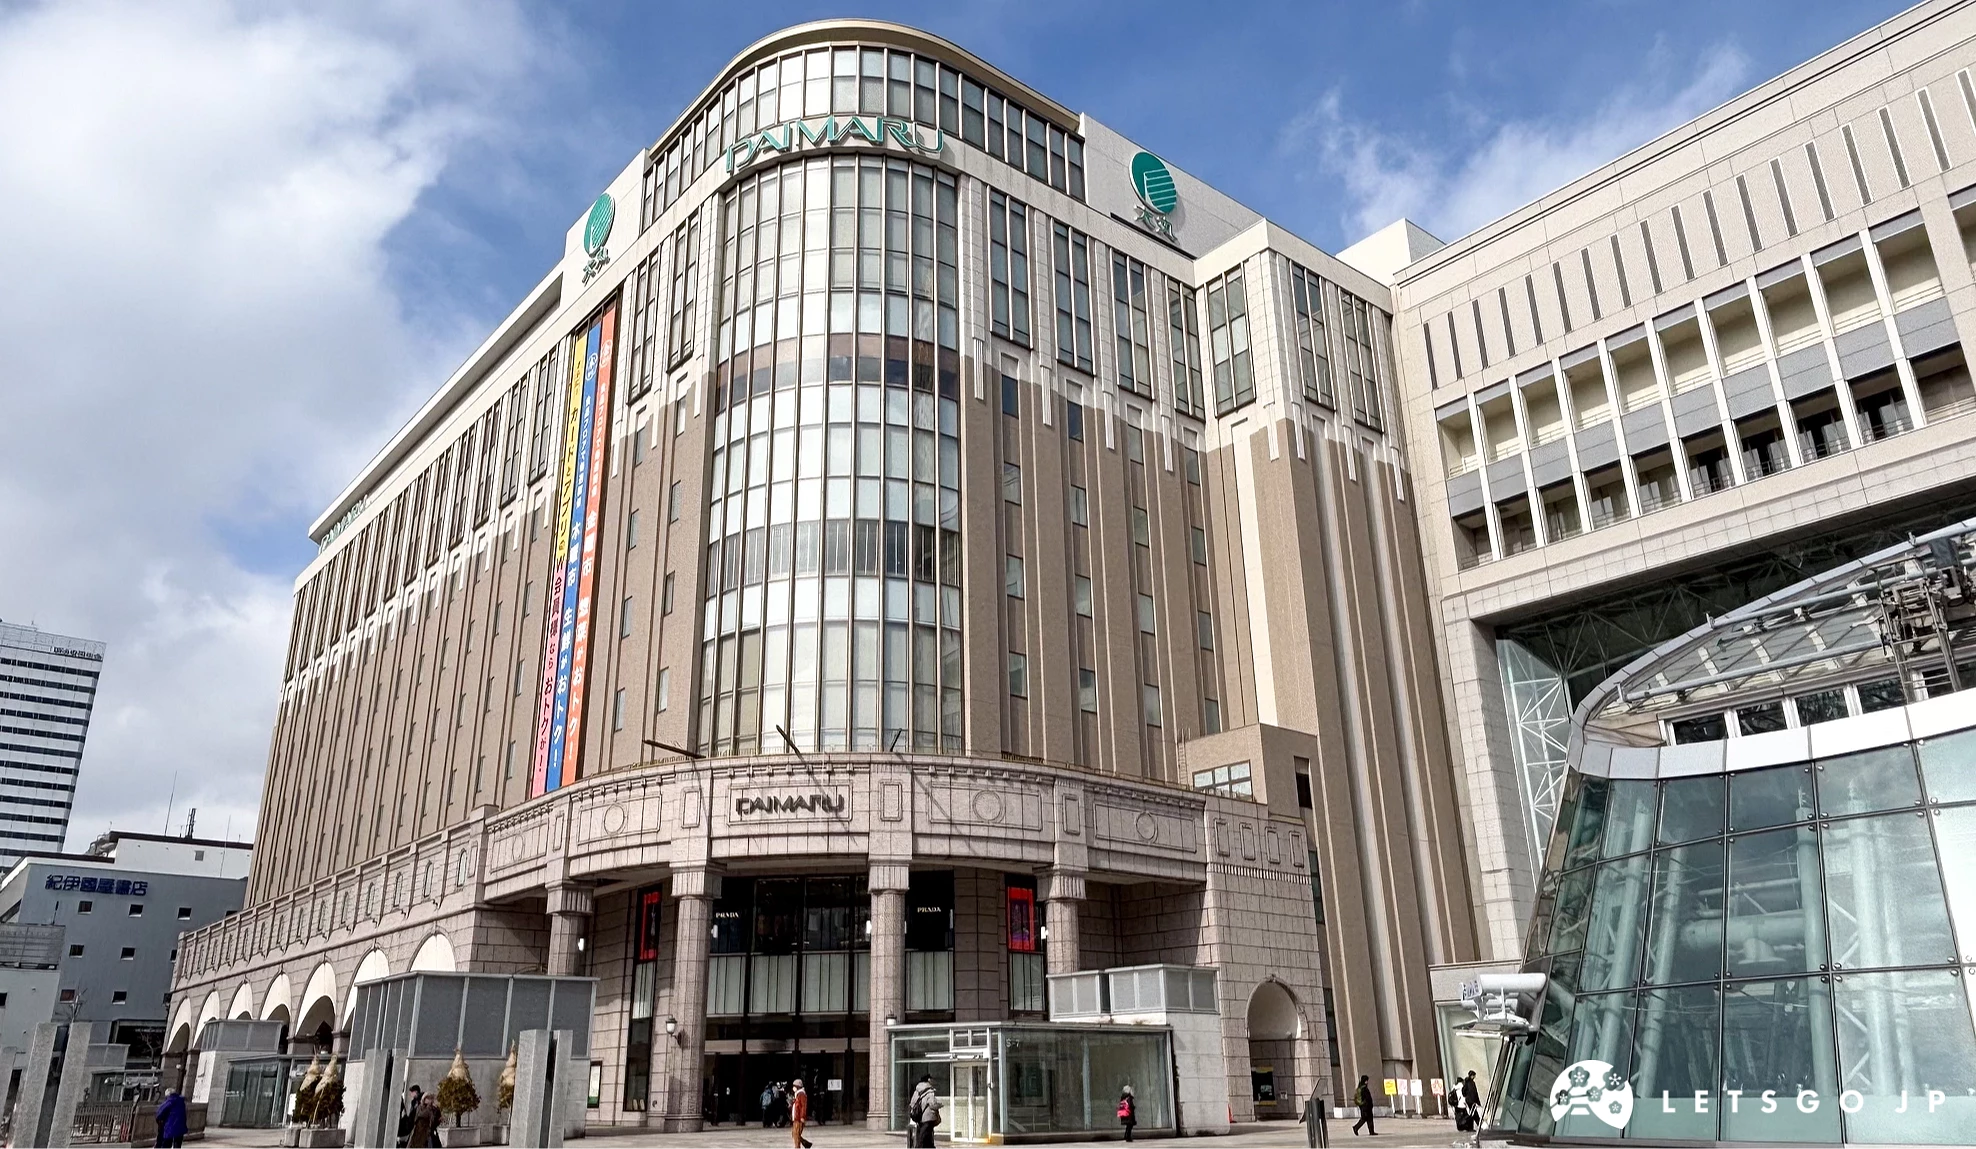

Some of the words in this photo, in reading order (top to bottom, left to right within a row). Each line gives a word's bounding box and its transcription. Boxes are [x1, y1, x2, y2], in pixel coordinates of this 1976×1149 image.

[726, 115, 943, 173] DAIMARU
[735, 794, 845, 816] DAIMARU
[715, 911, 740, 919] PRADA
